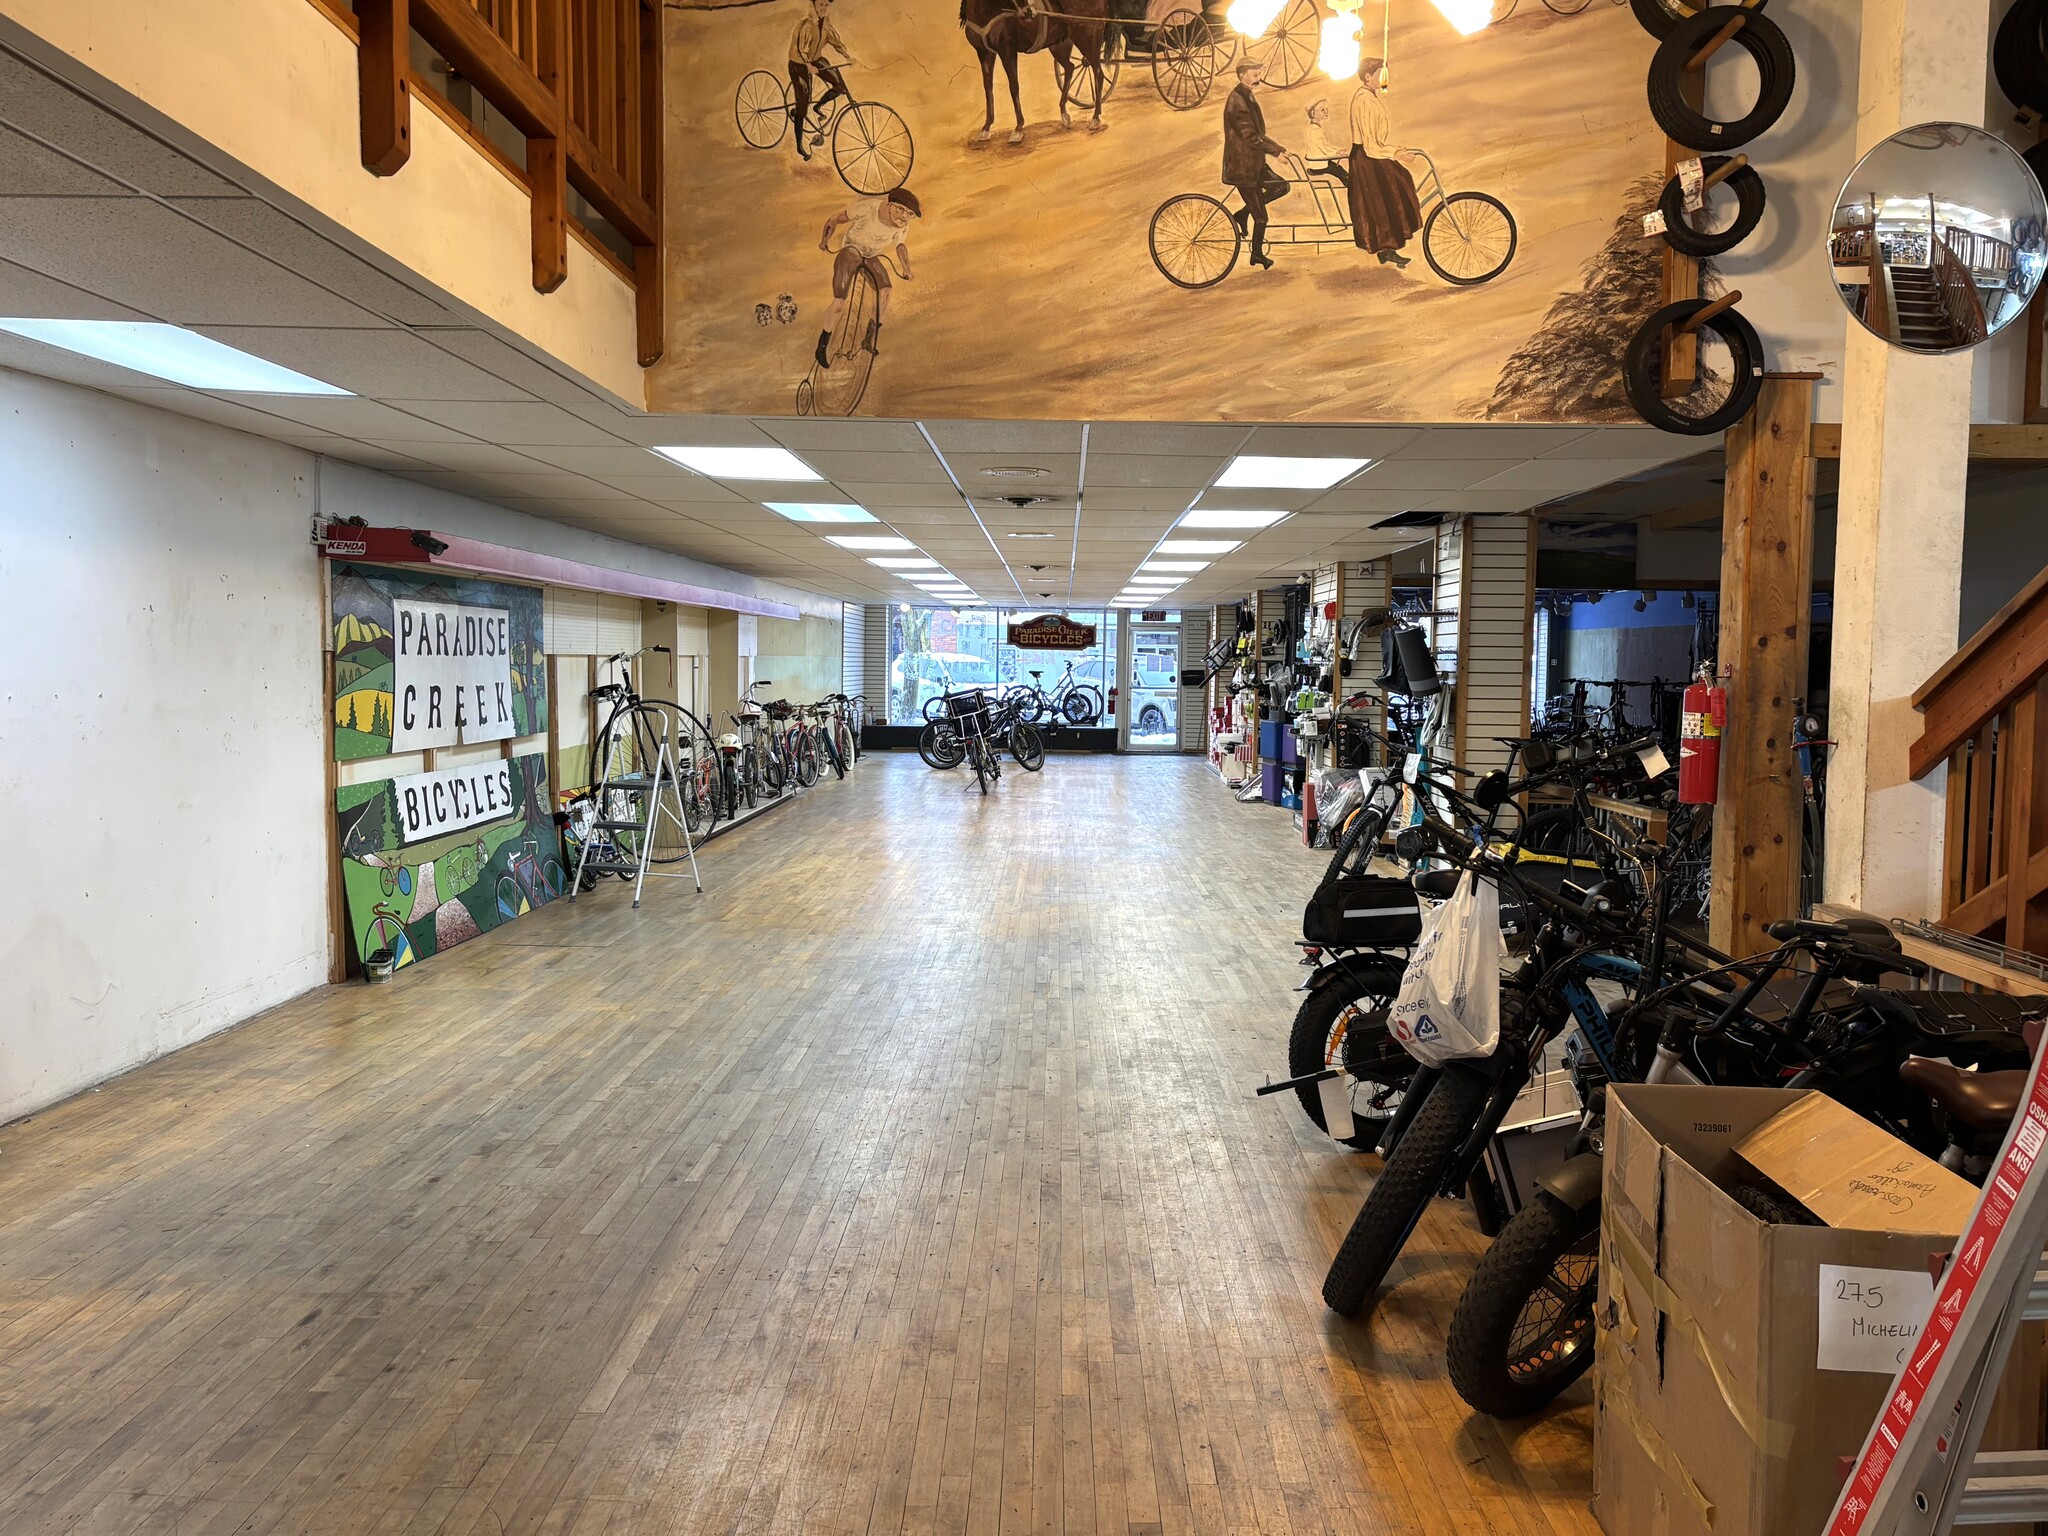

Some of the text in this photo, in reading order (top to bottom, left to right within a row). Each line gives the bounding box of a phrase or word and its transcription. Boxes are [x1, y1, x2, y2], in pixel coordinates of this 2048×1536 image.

[328, 541, 365, 551] KENDA
[1147, 611, 1164, 621] EXIT
[400, 610, 507, 657] PARADISE
[1015, 625, 1089, 635] PARADISE CREEK
[1020, 634, 1084, 645] BICYCLES
[403, 682, 508, 731] CREEK
[405, 771, 511, 832] BICYCLES
[2029, 1101, 2048, 1127] OSHA
[1693, 1123, 1731, 1133] 73239061
[2008, 1147, 2032, 1174] ANSI
[1998, 1178, 2016, 1197] DANGER
[1836, 1279, 1884, 1309] 27.5
[1882, 1424, 1899, 1448] CAUTION
